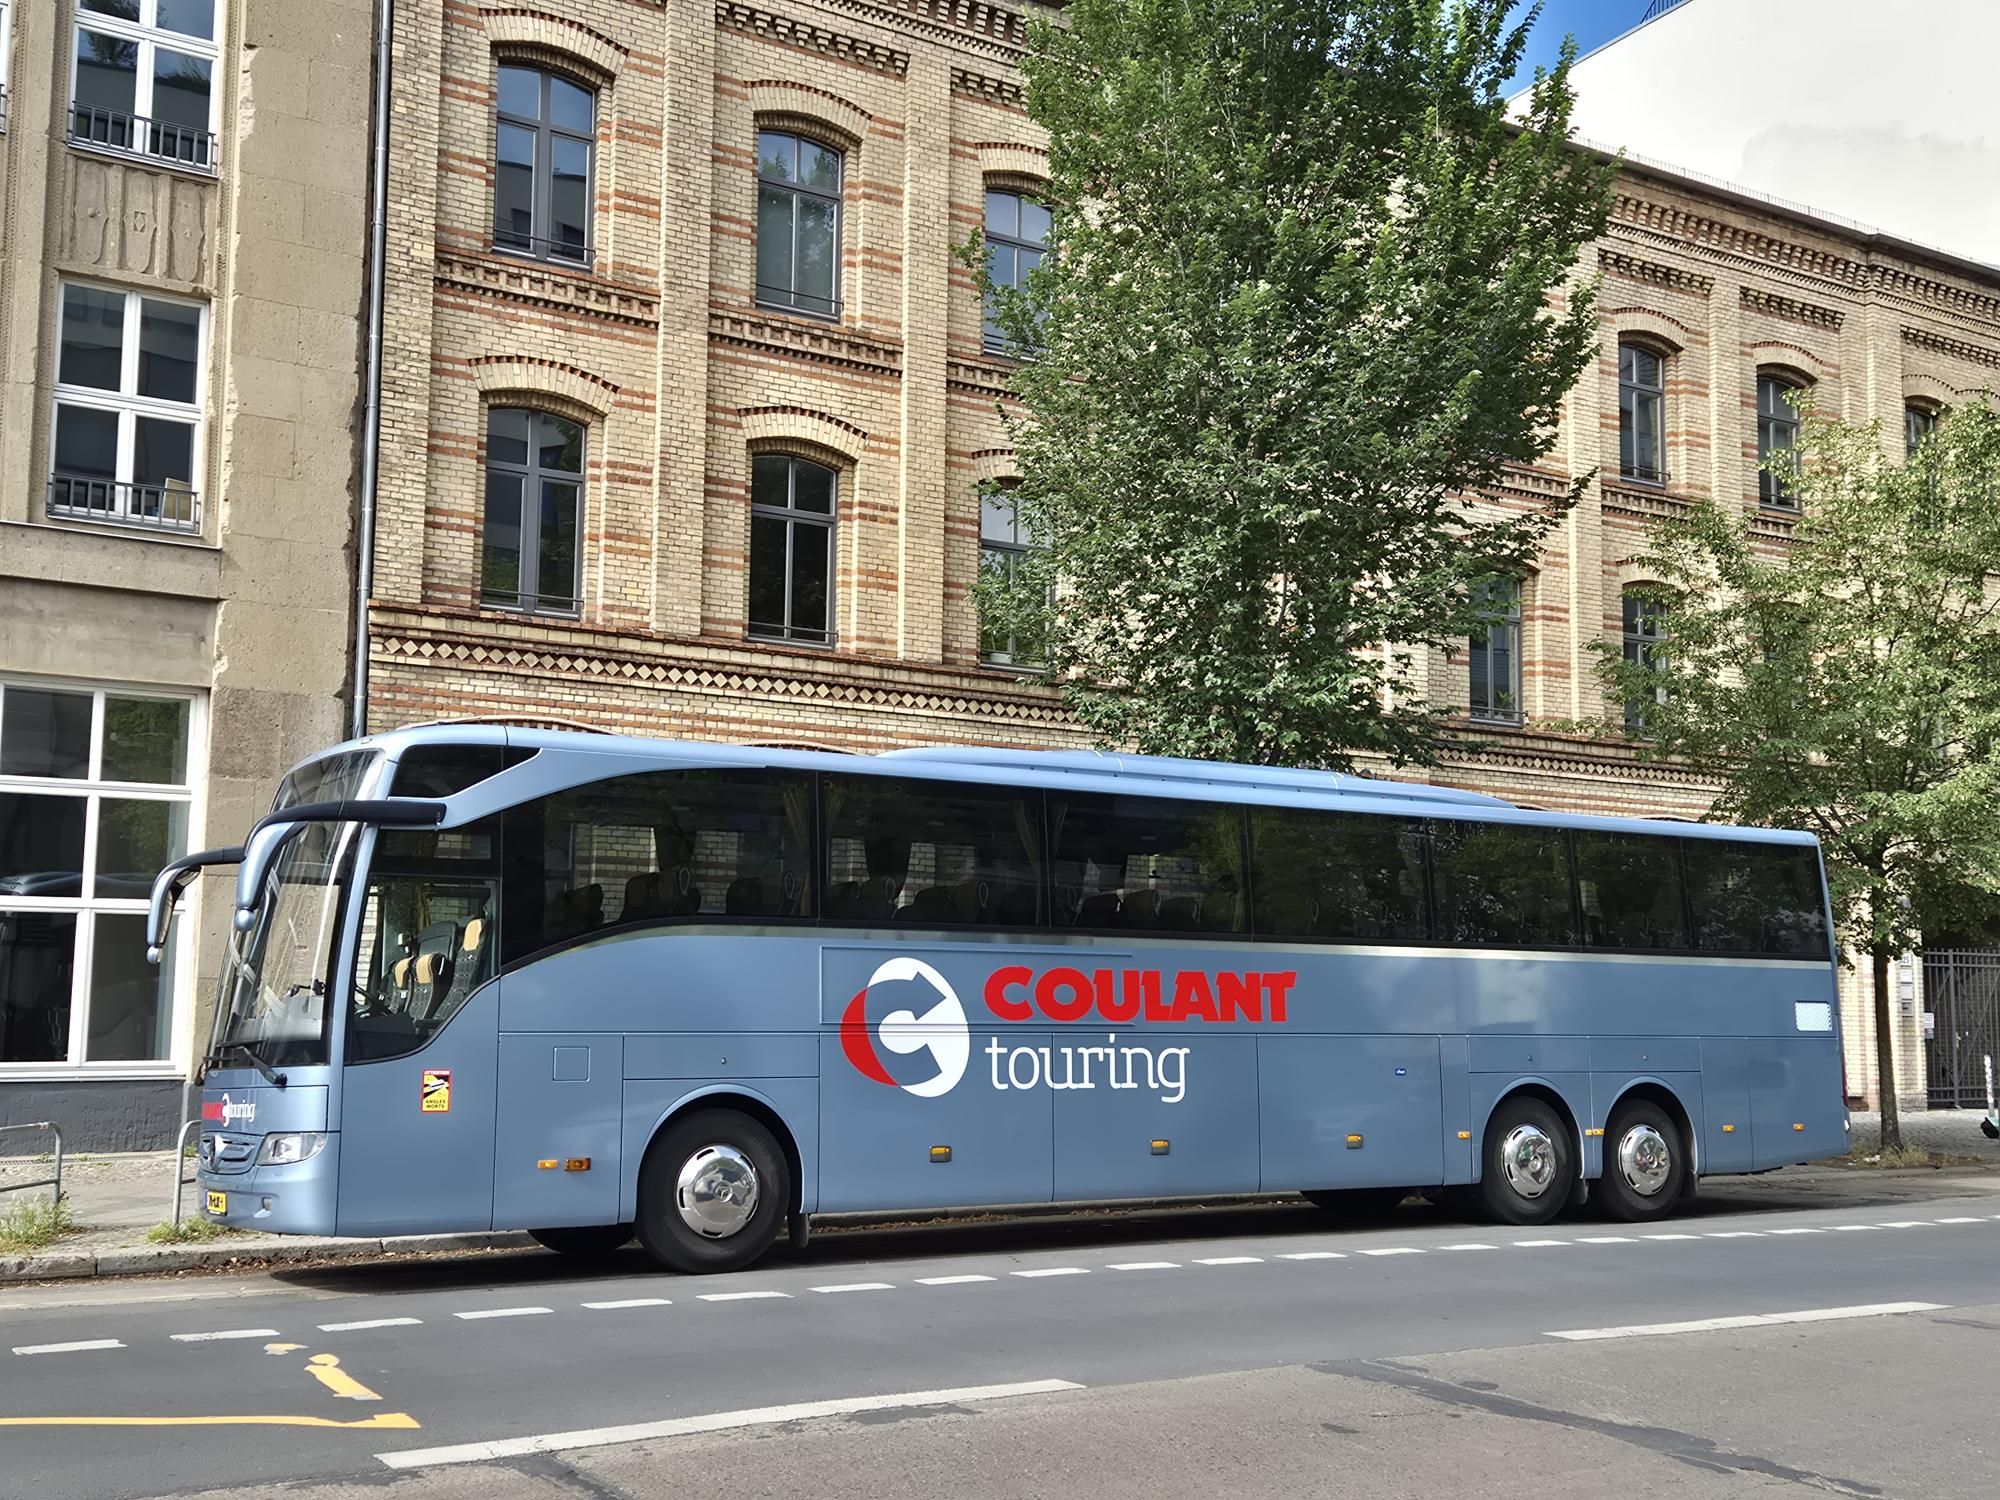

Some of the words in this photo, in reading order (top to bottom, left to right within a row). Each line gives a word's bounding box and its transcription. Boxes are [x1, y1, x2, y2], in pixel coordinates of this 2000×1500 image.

[983, 966, 1297, 1022] COULANT
[984, 1033, 1190, 1103] touring
[229, 1100, 256, 1122] touring
